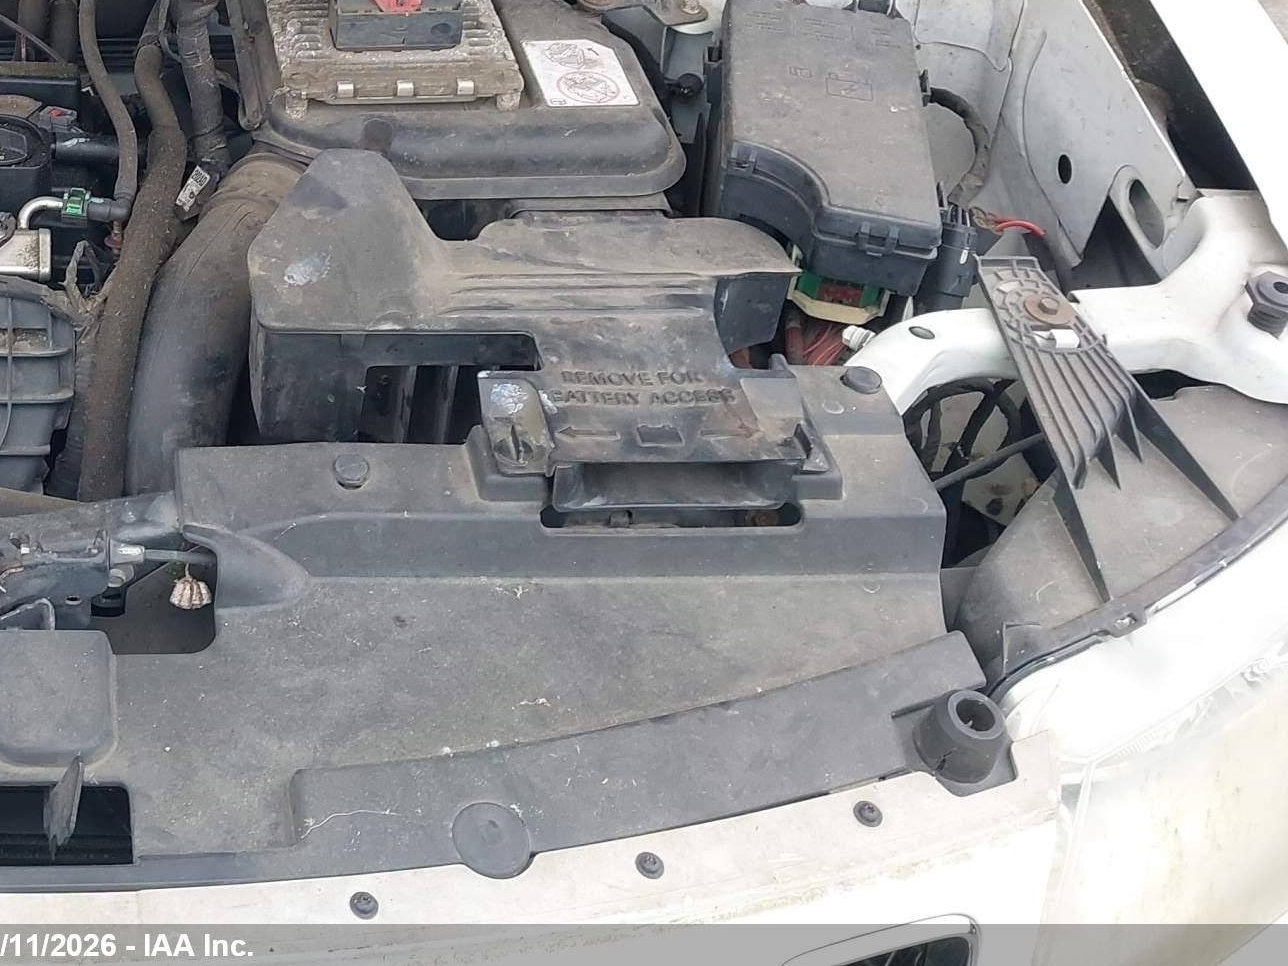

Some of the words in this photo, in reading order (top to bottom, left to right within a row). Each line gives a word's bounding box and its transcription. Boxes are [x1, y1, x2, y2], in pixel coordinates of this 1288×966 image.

[561, 370, 653, 386] REMOVE
[657, 370, 704, 384] FOR
[551, 389, 641, 405] BATTERY
[648, 388, 737, 405] ACCESS
